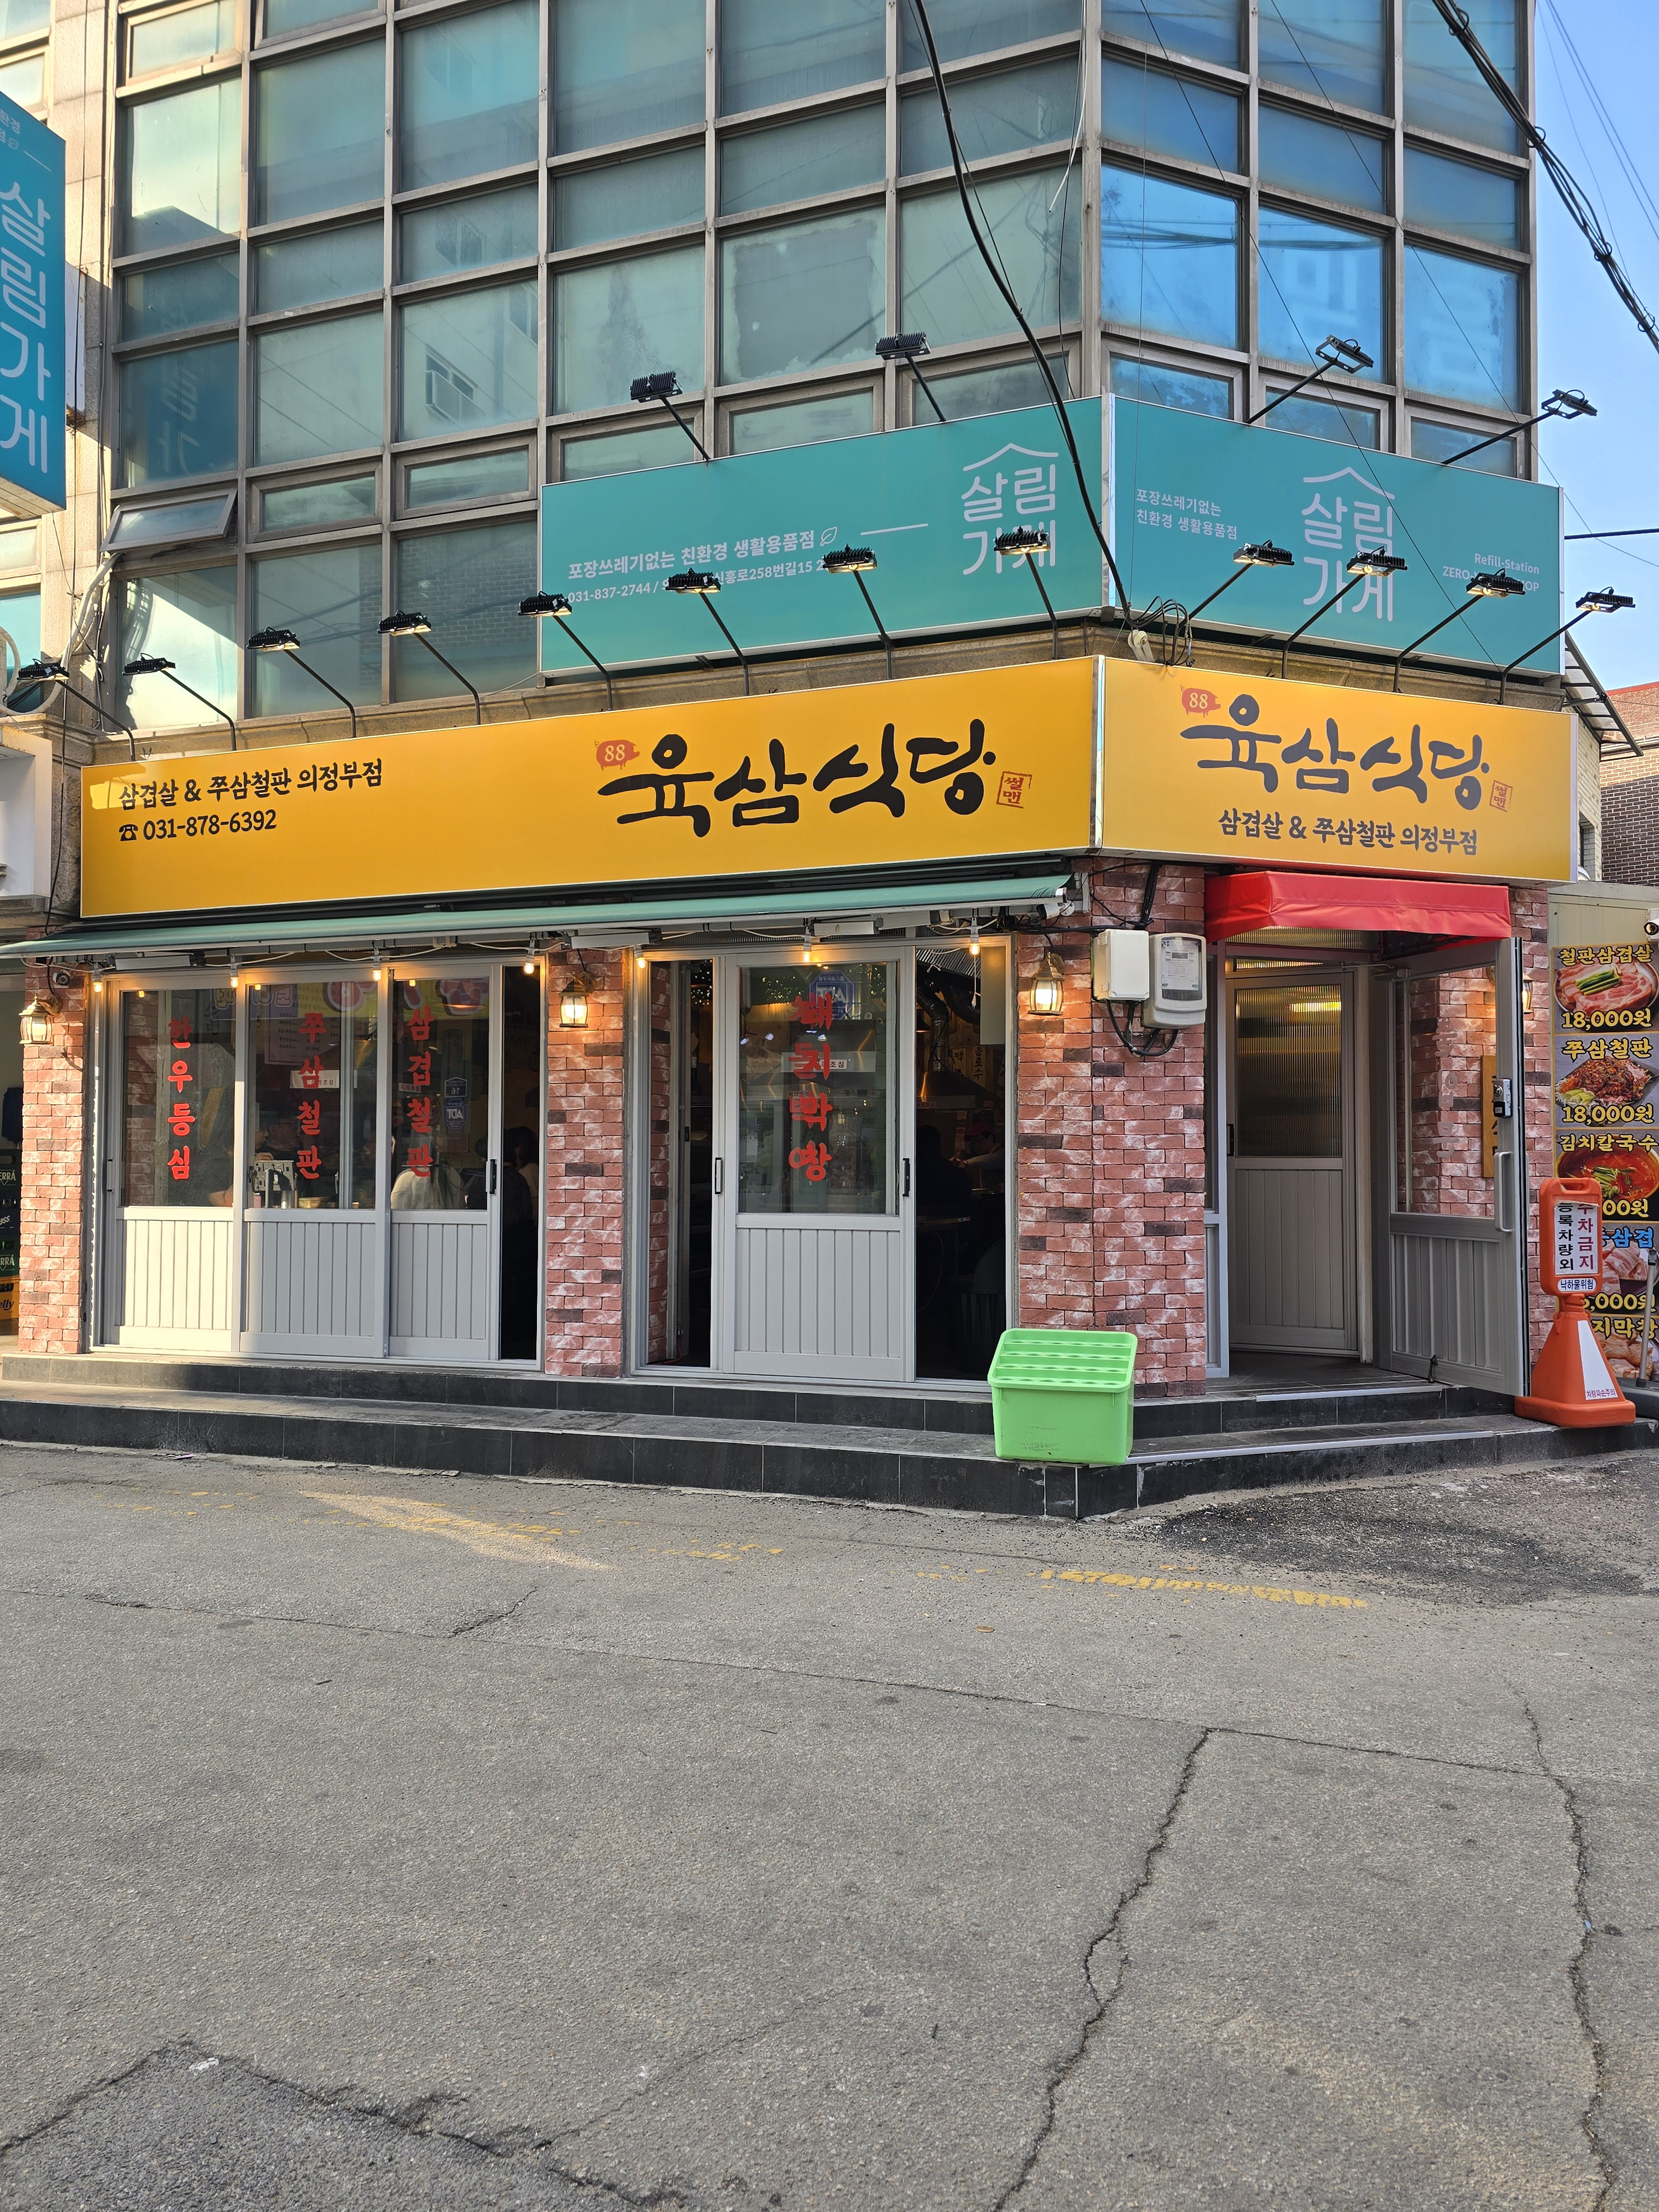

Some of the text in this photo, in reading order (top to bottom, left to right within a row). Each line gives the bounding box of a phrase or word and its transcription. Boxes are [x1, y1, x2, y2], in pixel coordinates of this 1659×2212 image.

[0, 181, 50, 474] 살림가게
[961, 463, 1056, 522] 살림
[1136, 488, 1221, 517] 포장쓰레기없는
[1136, 509, 1237, 540] 친환경 생활용품점
[1301, 492, 1392, 556] 살림
[568, 529, 815, 579] 포장쓰레기없는 친환경 생활용품점
[1474, 553, 1540, 575] Refill-Station
[568, 582, 651, 603] 031-837-2744
[1189, 692, 1208, 709] 88
[604, 744, 625, 762] 88
[1180, 693, 1489, 810] 육삼식당
[118, 779, 179, 811] 삼겹살
[184, 779, 202, 802] &
[297, 758, 383, 792] 의정부점
[597, 718, 996, 838] 육삼식당
[143, 809, 277, 841] 031-878-6392
[1218, 807, 1284, 839] 삼겹살
[1289, 816, 1307, 839] &
[1400, 823, 1478, 855] 의정부점
[1558, 944, 1654, 966] 철판삼겹살
[1562, 1008, 1653, 1031] 18,000원
[973, 1047, 983, 1080] 음료수
[168, 1015, 196, 1180] 한우등심
[406, 1005, 435, 1177] 삼겹철판
[1562, 1104, 1655, 1125] 18,000원
[1559, 1133, 1658, 1153] 김치칼국수
[1603, 1198, 1649, 1218] 00원
[1577, 1203, 1594, 1270] 주차금지
[1602, 1227, 1653, 1248] 삼겹
[1561, 1279, 1593, 1290] 낙하물위험
[0, 1299, 14, 1311] elly
[1590, 1317, 1658, 1340] 지막창
[1587, 1388, 1615, 1399] 차량파손주의
